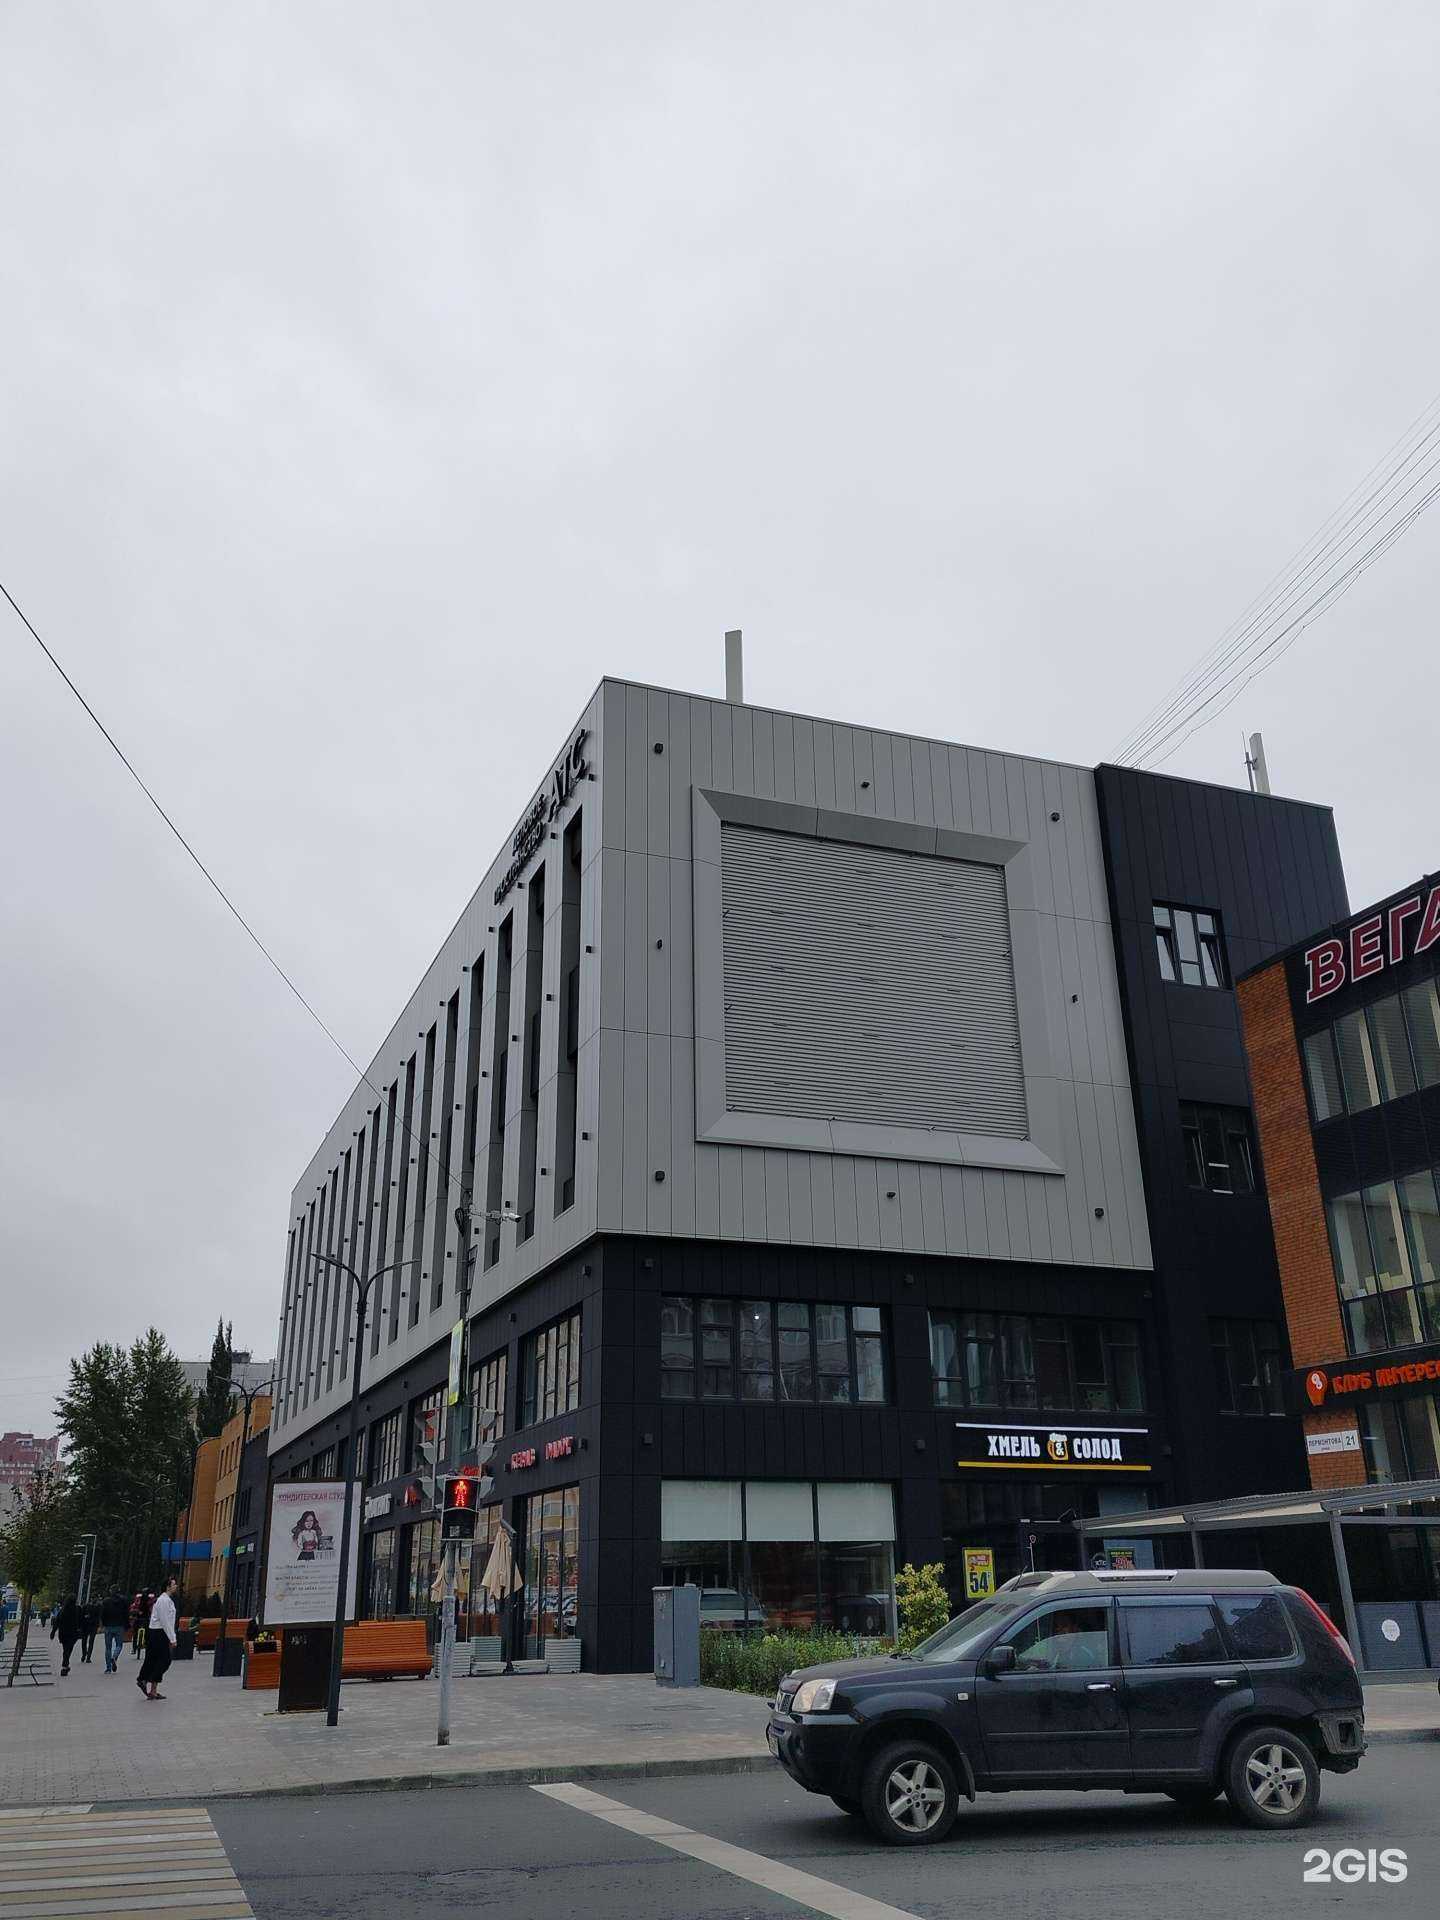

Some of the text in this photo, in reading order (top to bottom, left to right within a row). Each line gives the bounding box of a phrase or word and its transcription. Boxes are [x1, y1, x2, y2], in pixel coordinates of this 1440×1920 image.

[987, 1435, 1041, 1458] ХМЕЛЬ
[1073, 1438, 1122, 1461] СОЛОД
[1346, 1435, 1356, 1446] 21
